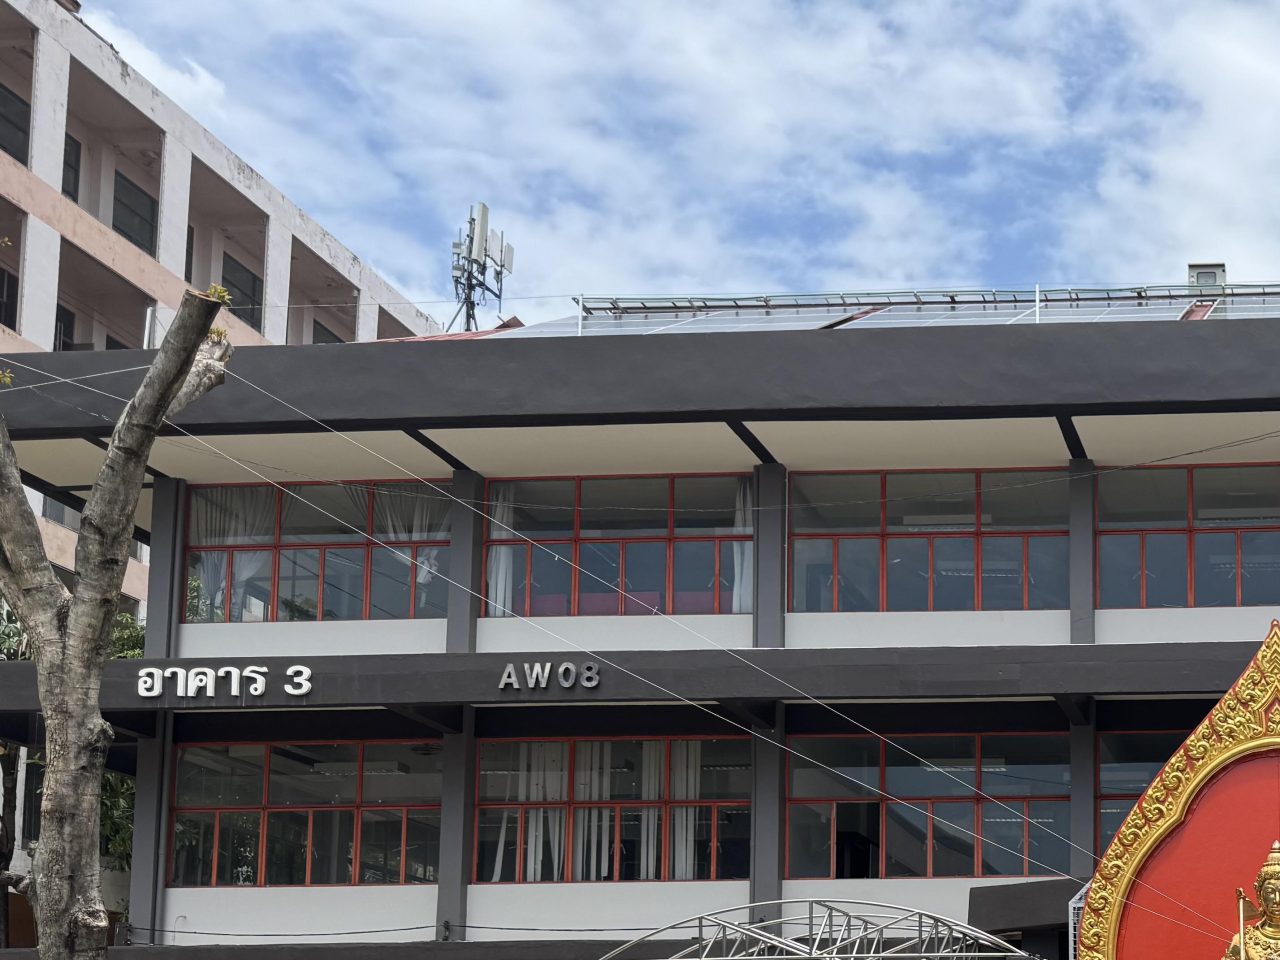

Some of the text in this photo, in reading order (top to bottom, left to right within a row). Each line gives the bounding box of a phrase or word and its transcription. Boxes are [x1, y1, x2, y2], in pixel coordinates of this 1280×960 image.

[138, 665, 312, 697] อาคาร 3
[498, 661, 600, 689] AW08
